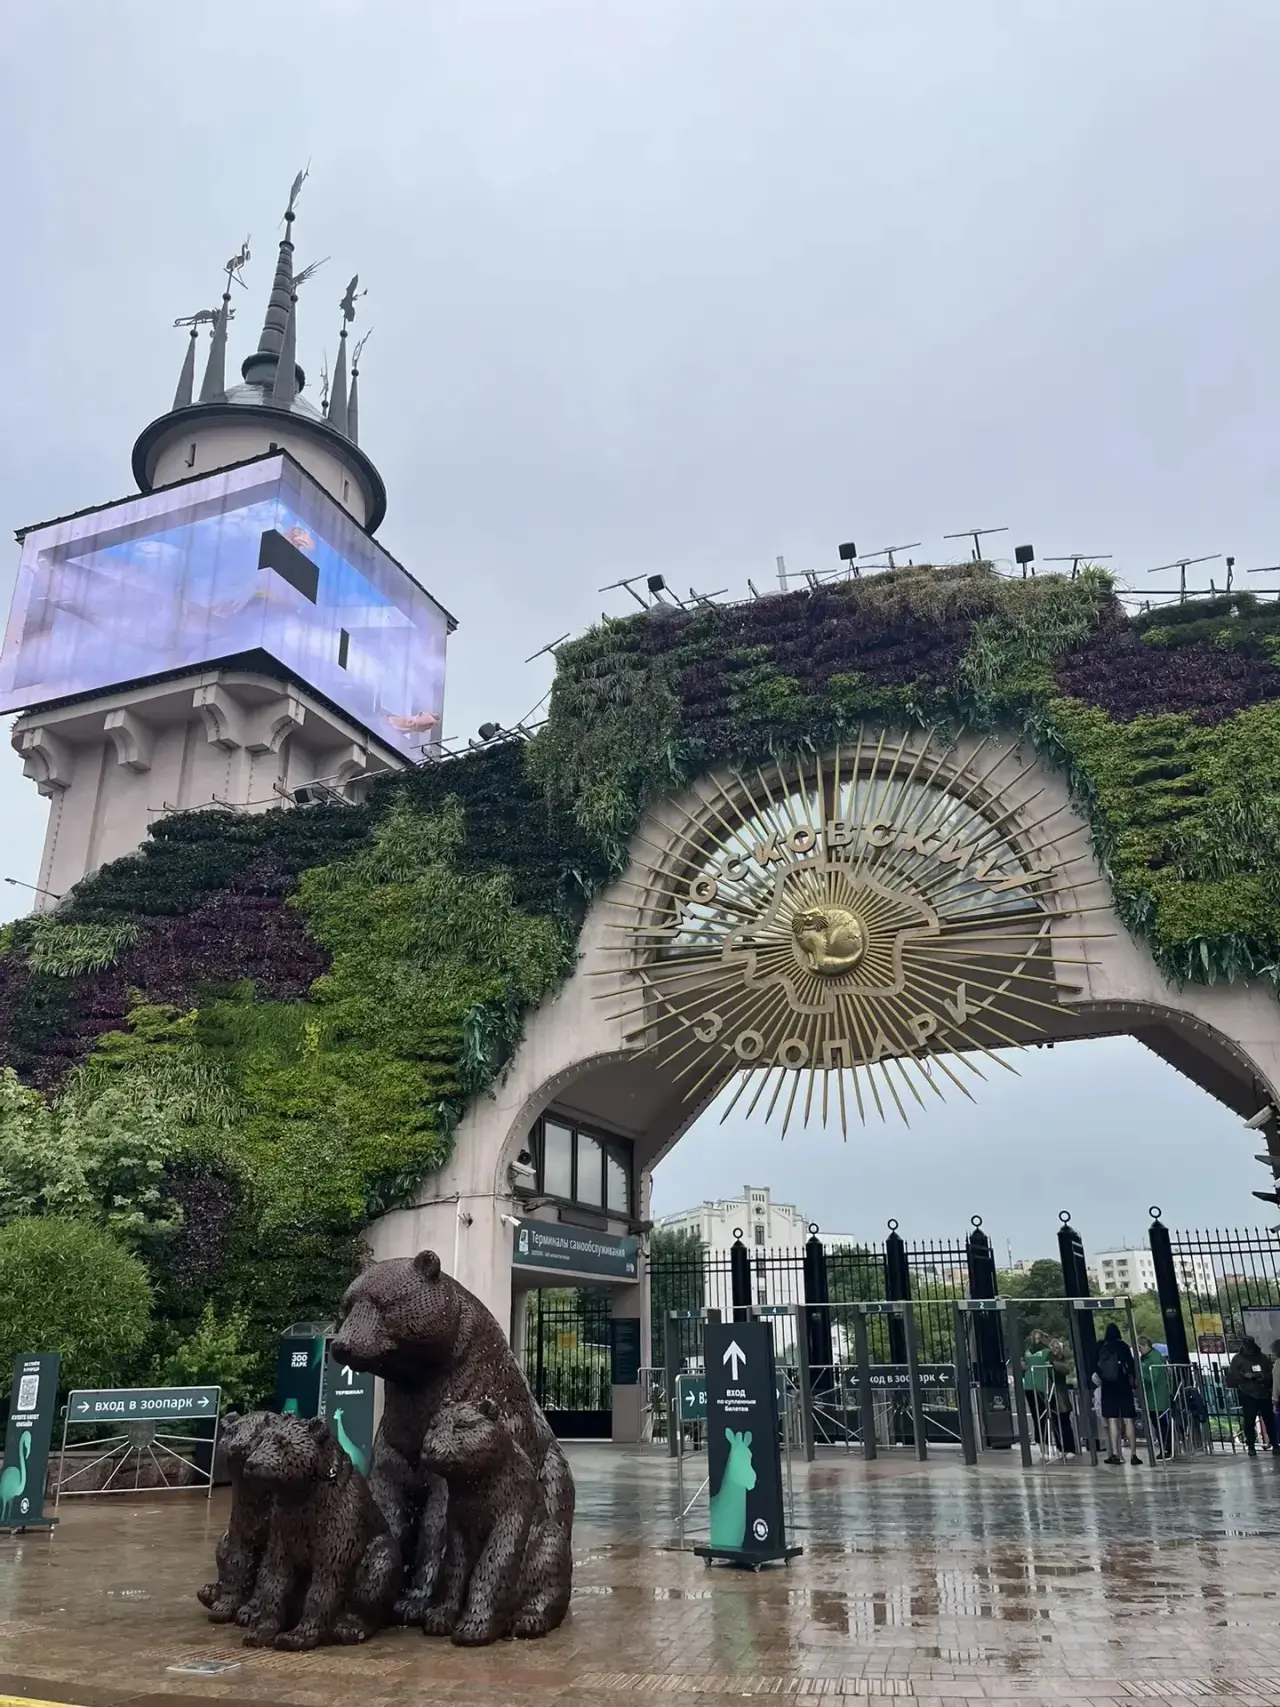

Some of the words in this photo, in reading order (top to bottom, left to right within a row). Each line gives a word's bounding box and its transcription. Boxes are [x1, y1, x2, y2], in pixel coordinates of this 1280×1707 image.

[626, 820, 1057, 936] МОСКОВСКИЙ
[693, 983, 982, 1070] ЗООПАРК
[531, 1230, 568, 1248] Терминалы
[569, 1240, 626, 1258] самообслуживания
[291, 1354, 308, 1362] ЗОО
[726, 1389, 746, 1398] ВХОД
[94, 1401, 125, 1412] вход
[129, 1400, 137, 1410] в
[140, 1397, 193, 1411] зоопарк
